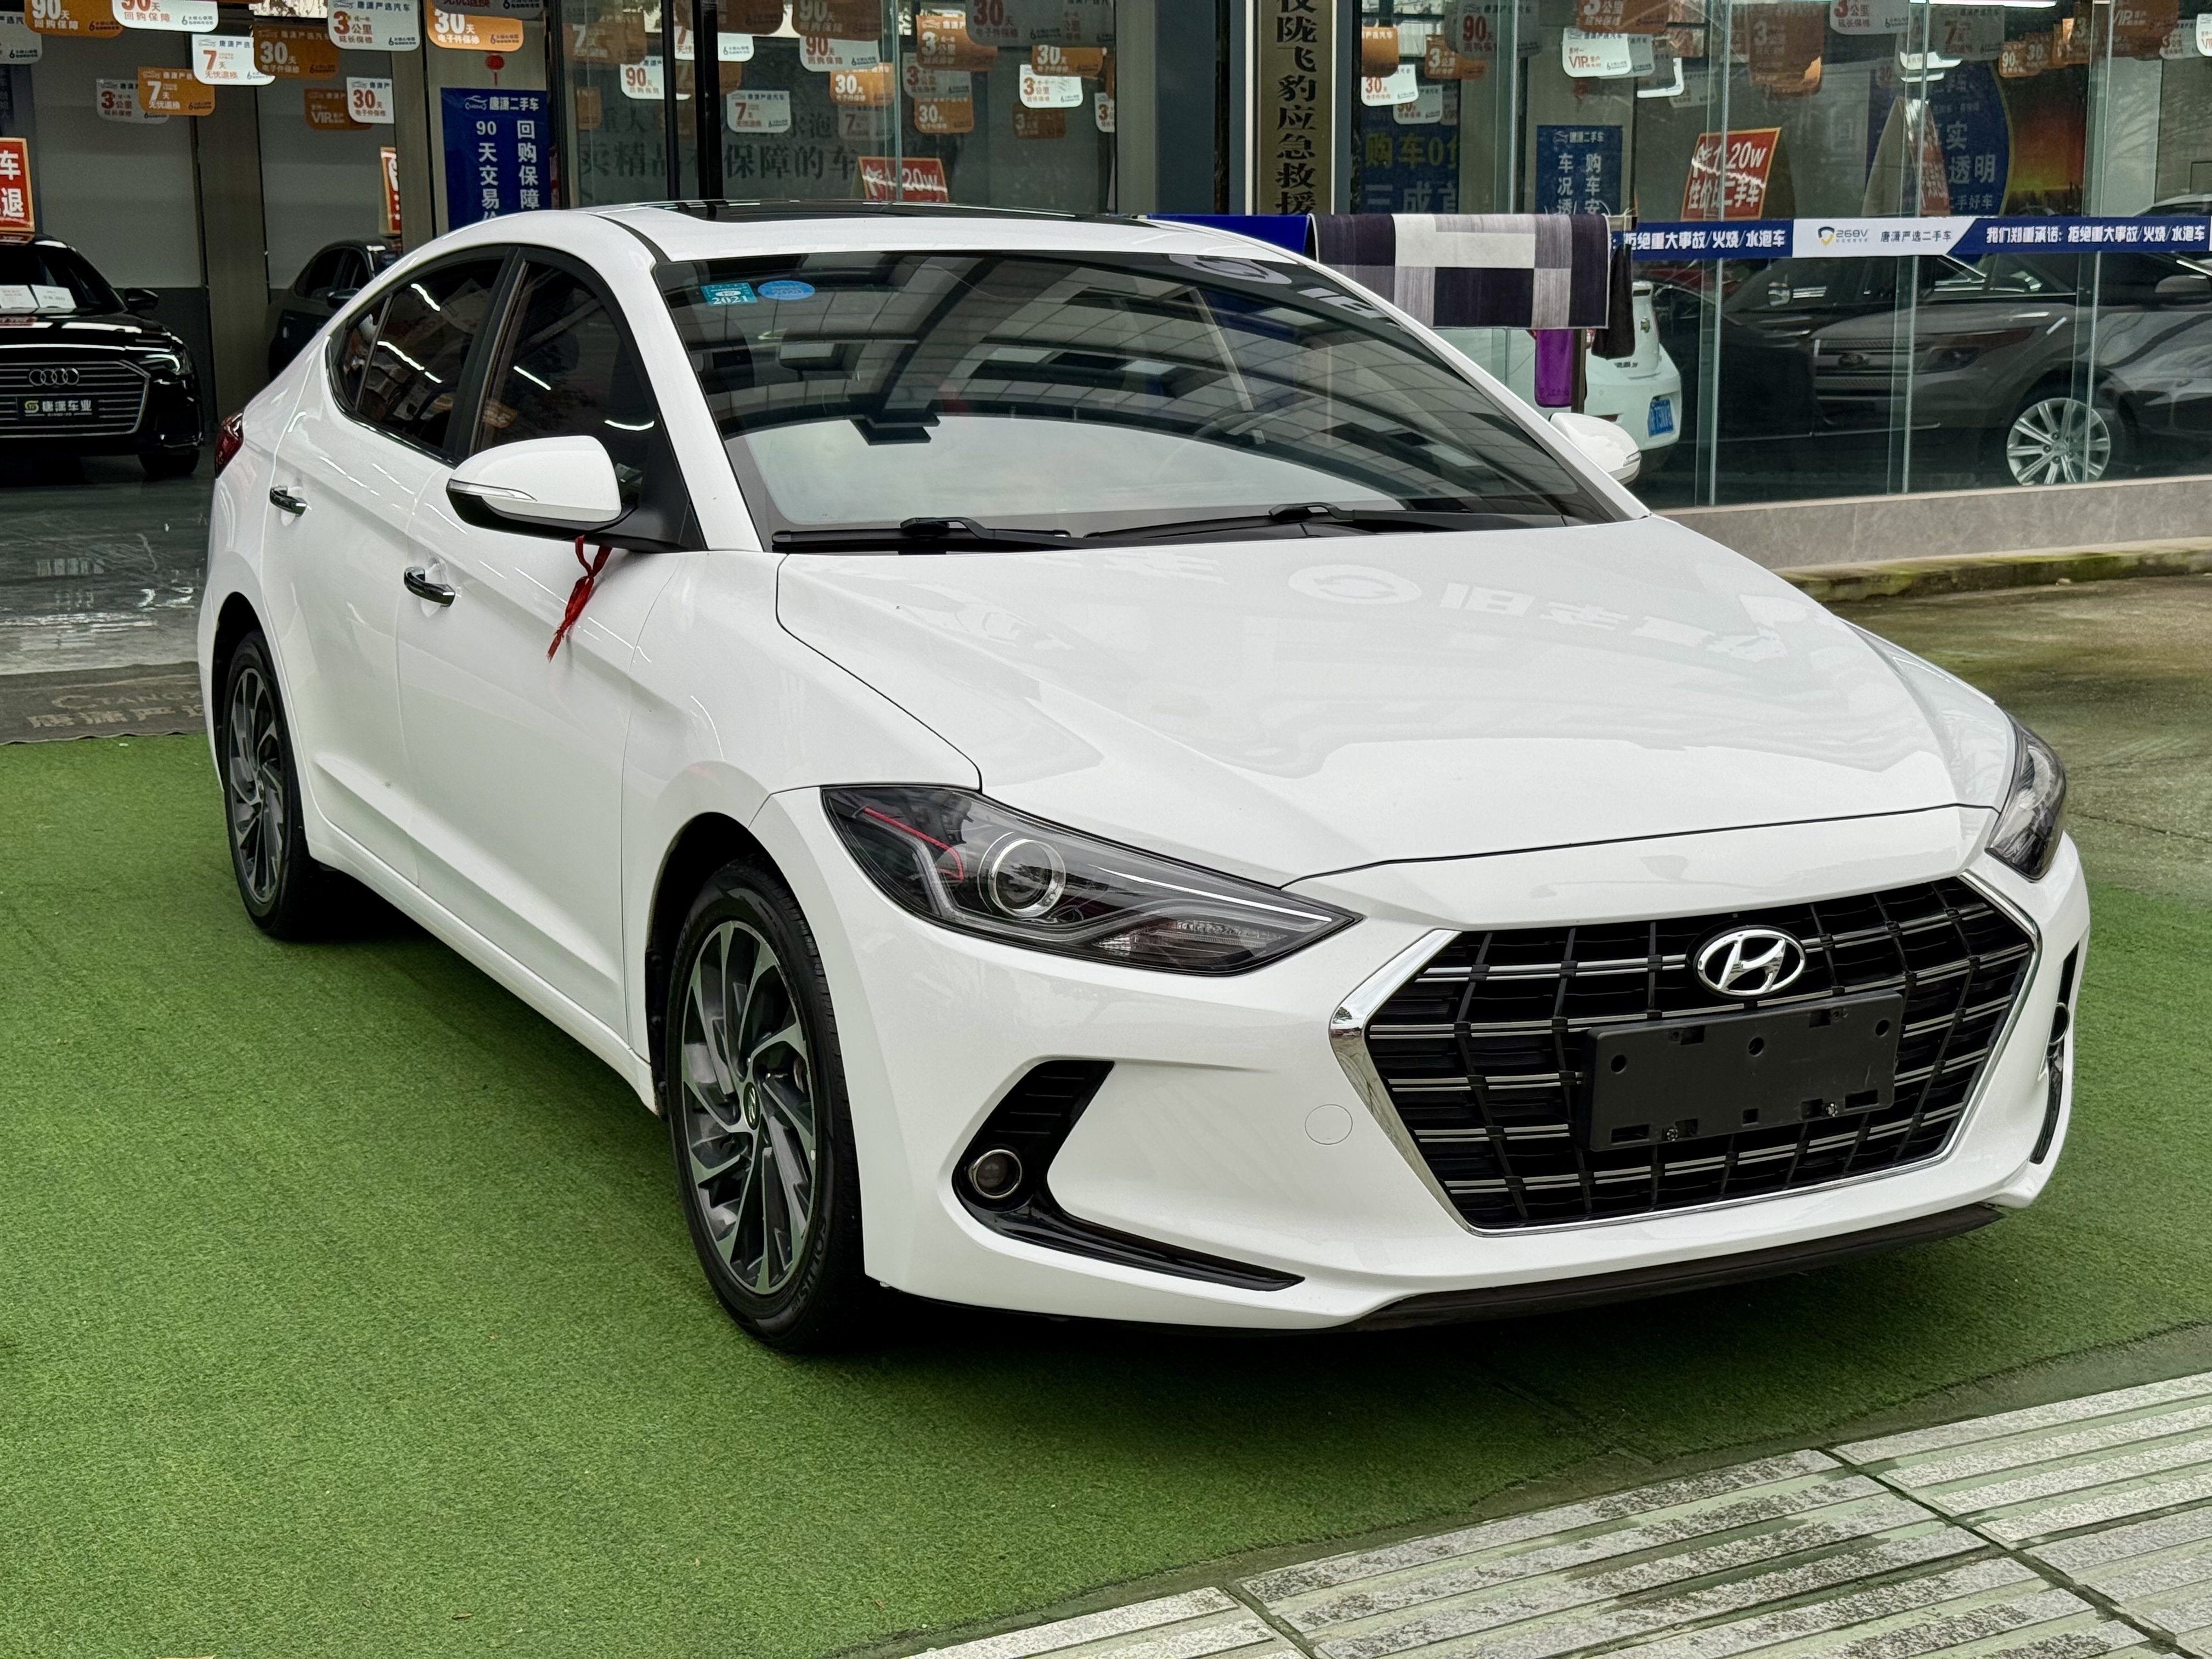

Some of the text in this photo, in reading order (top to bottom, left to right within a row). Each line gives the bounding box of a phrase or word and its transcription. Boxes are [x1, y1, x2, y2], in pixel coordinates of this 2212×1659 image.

[124, 11, 170, 22] 回购保障
[34, 19, 78, 30] 回购保障
[1568, 56, 1588, 69] VIP
[516, 120, 540, 210] 回购保障
[1948, 154, 1996, 184] 透明
[1610, 229, 1786, 250] ：拒绝重大事故/火烧/水泡车
[1880, 230, 1952, 242] 唐潇严选二手车
[712, 296, 749, 305] 2021
